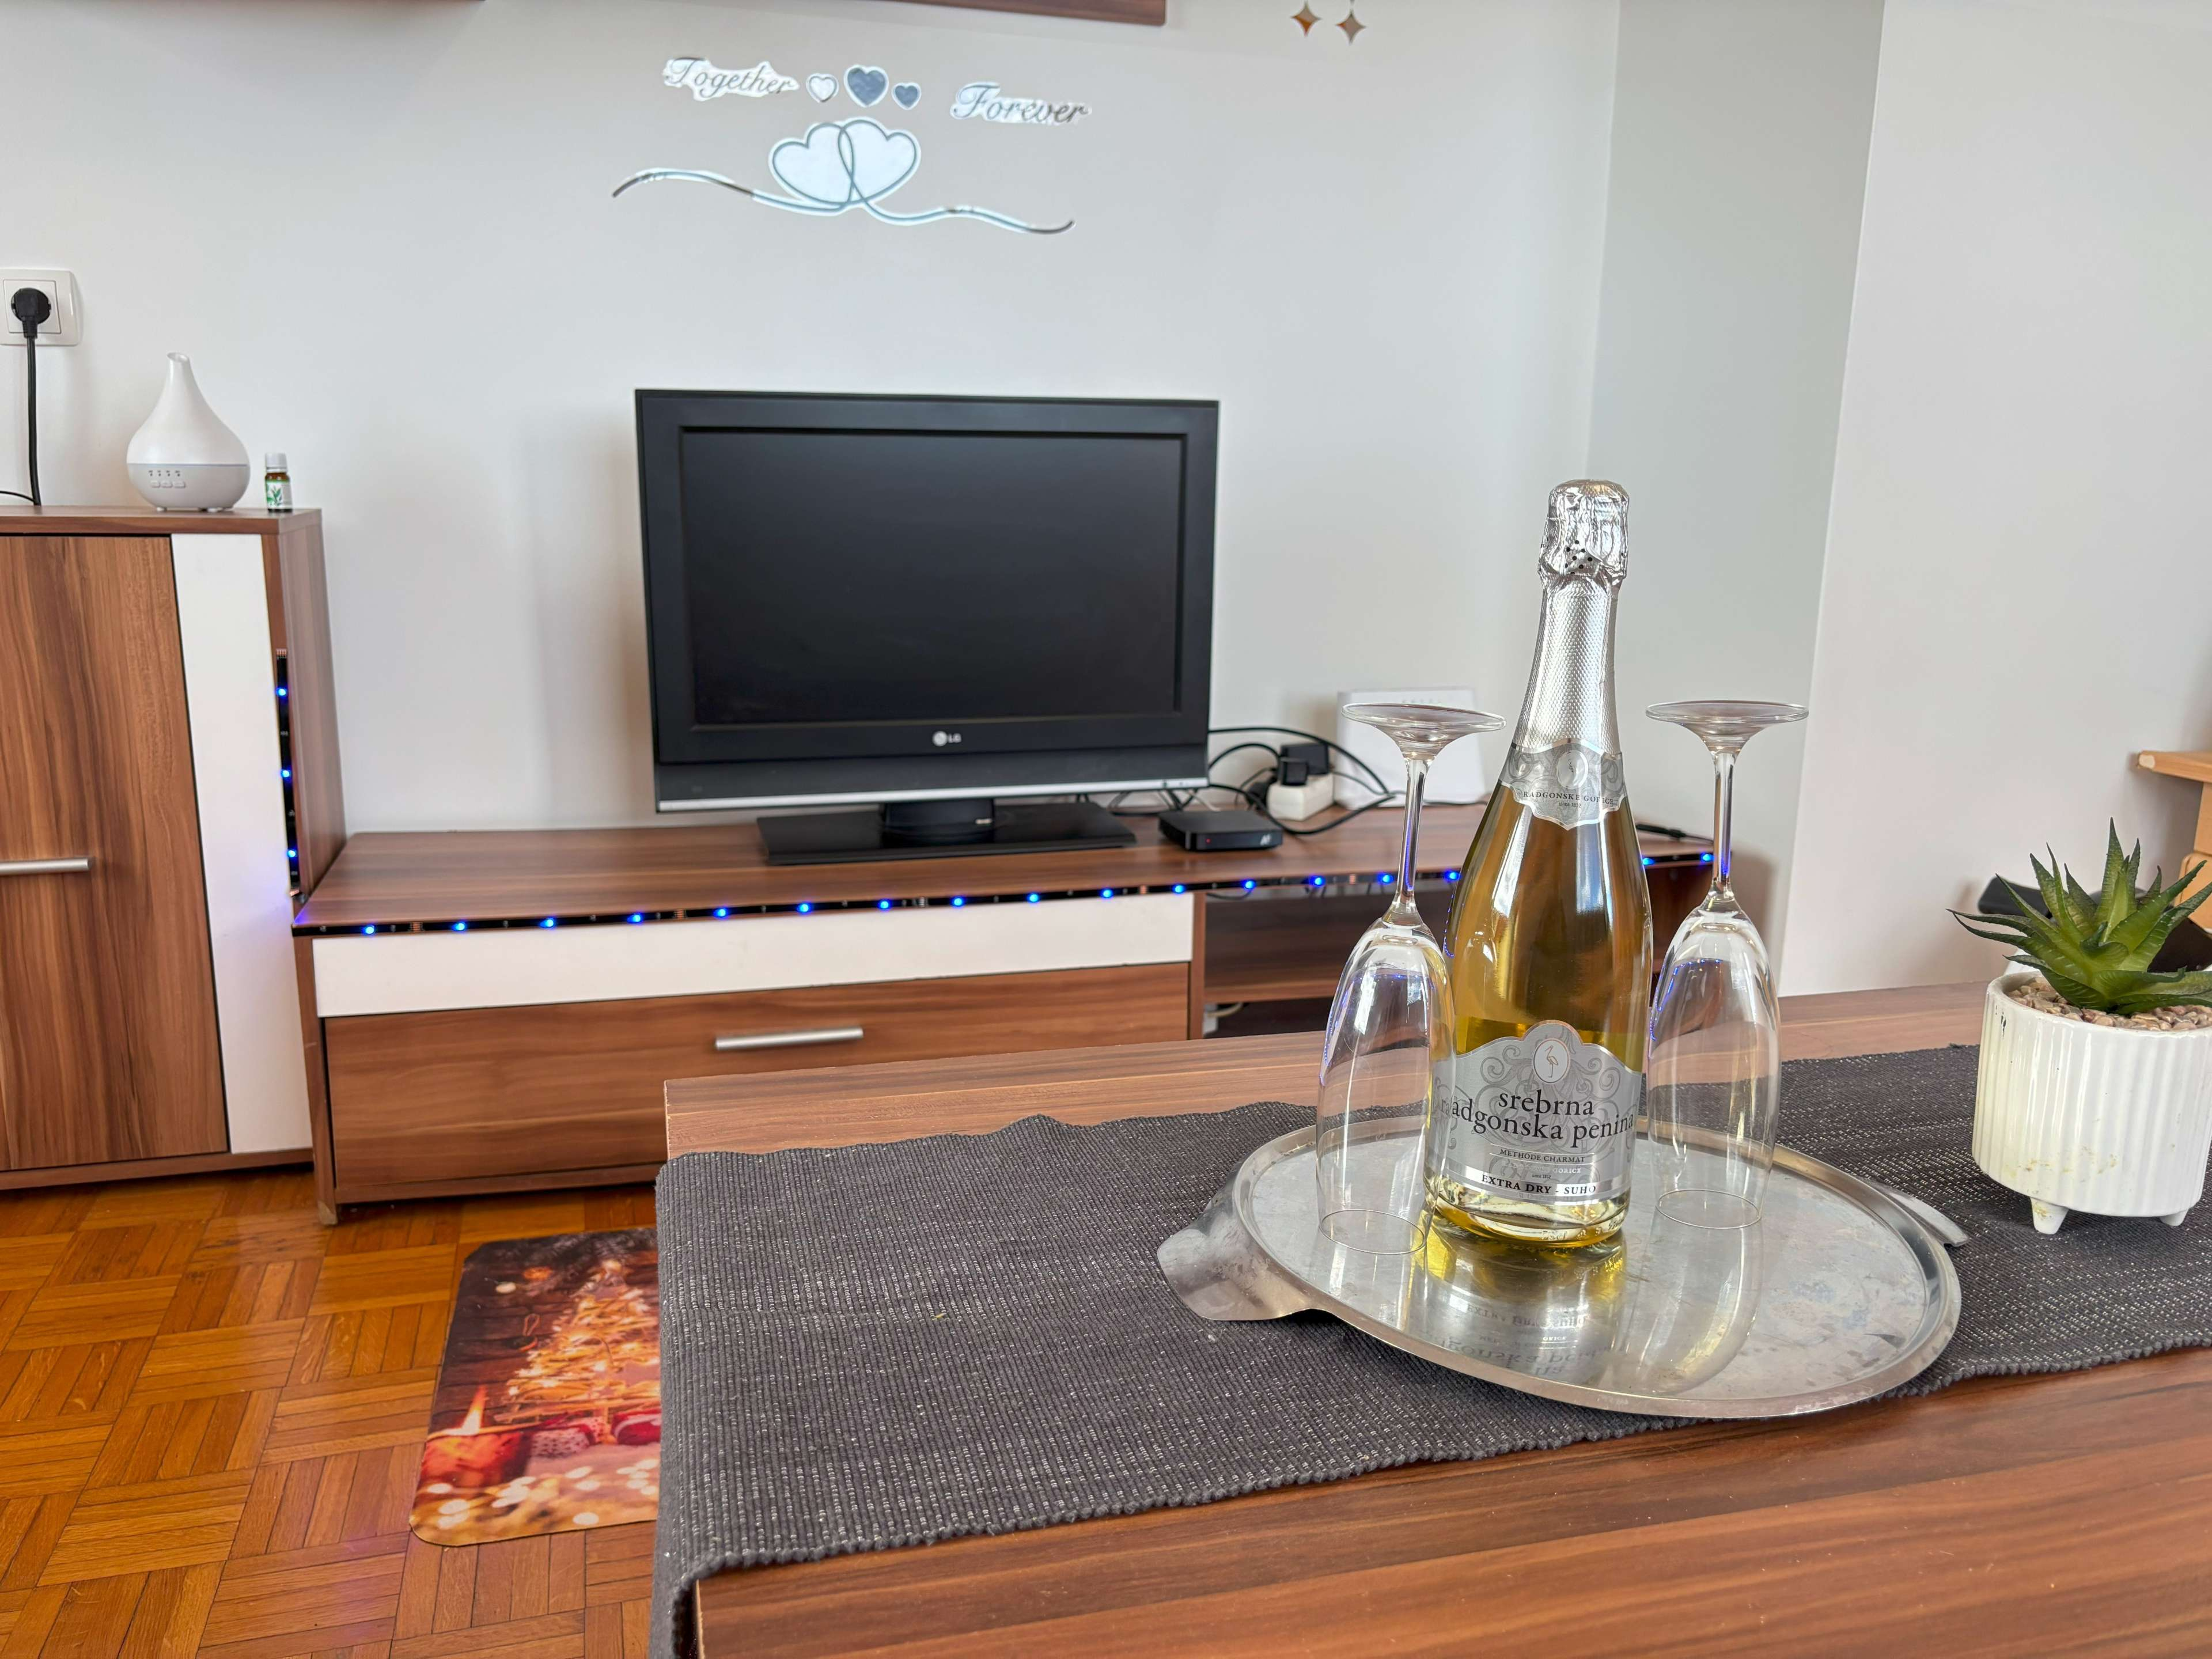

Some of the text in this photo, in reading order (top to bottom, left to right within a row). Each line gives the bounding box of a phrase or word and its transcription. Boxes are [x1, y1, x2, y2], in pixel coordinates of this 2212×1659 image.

[665, 56, 794, 98] Together
[953, 84, 1088, 123] Forever
[1524, 791, 1580, 801] RADGONSKE
[1499, 1089, 1594, 1115] srebrna
[1570, 1114, 1633, 1147] penina
[1500, 1149, 1541, 1161] METHODE
[1482, 1175, 1521, 1190] EXTRA
[1526, 1184, 1552, 1194] DRY
[1564, 1185, 1596, 1194] SUHO
